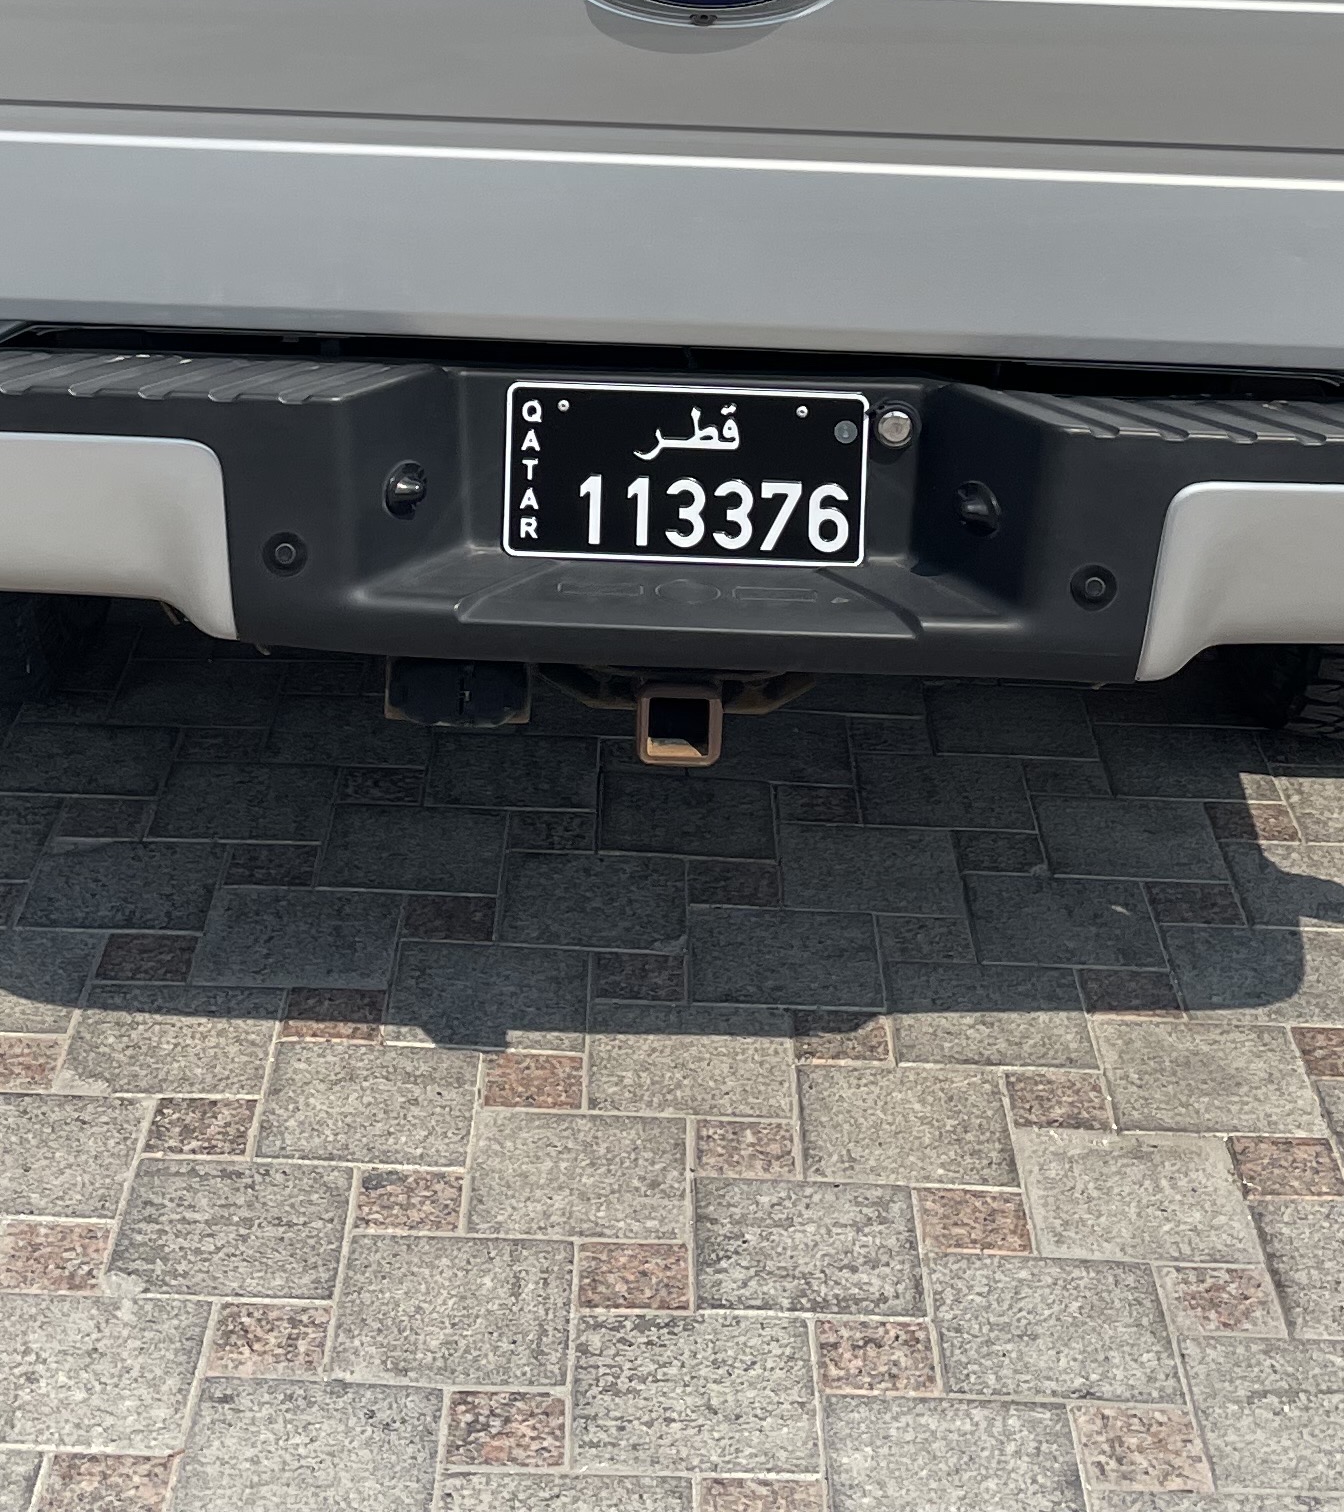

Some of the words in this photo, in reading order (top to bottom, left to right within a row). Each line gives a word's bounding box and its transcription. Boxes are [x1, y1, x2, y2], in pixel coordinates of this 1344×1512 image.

[519, 399, 543, 540] QATAR
[633, 402, 740, 461] قطر
[579, 473, 850, 553] 113376
